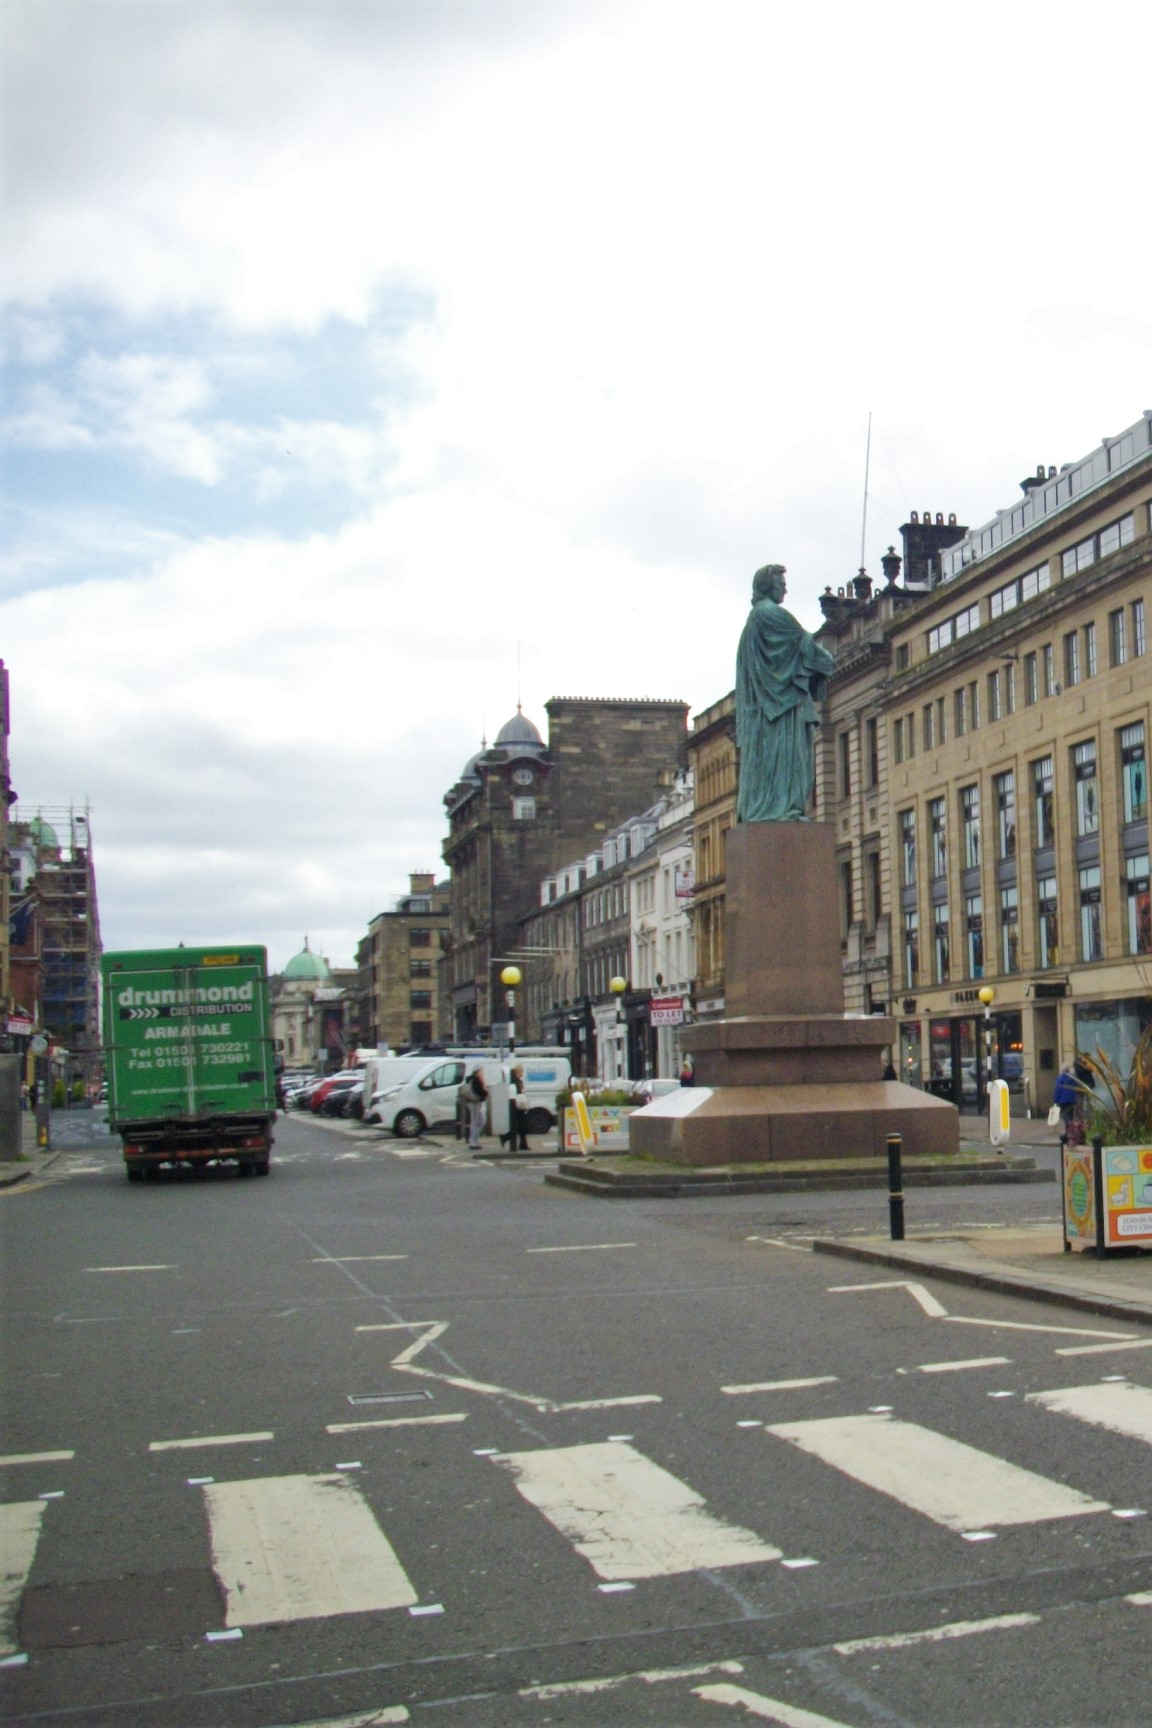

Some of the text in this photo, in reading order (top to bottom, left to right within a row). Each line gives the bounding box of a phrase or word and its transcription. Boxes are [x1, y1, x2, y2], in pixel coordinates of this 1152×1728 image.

[118, 981, 253, 1006] drummond
[169, 1003, 252, 1017] DISTRIBUTION
[666, 1010, 682, 1018] LET
[144, 1023, 232, 1039] ARMADALE
[130, 1047, 151, 1058] Tel
[201, 1042, 249, 1054] 730221
[128, 1059, 153, 1069] Fax
[1122, 1224, 1139, 1232] CITY
